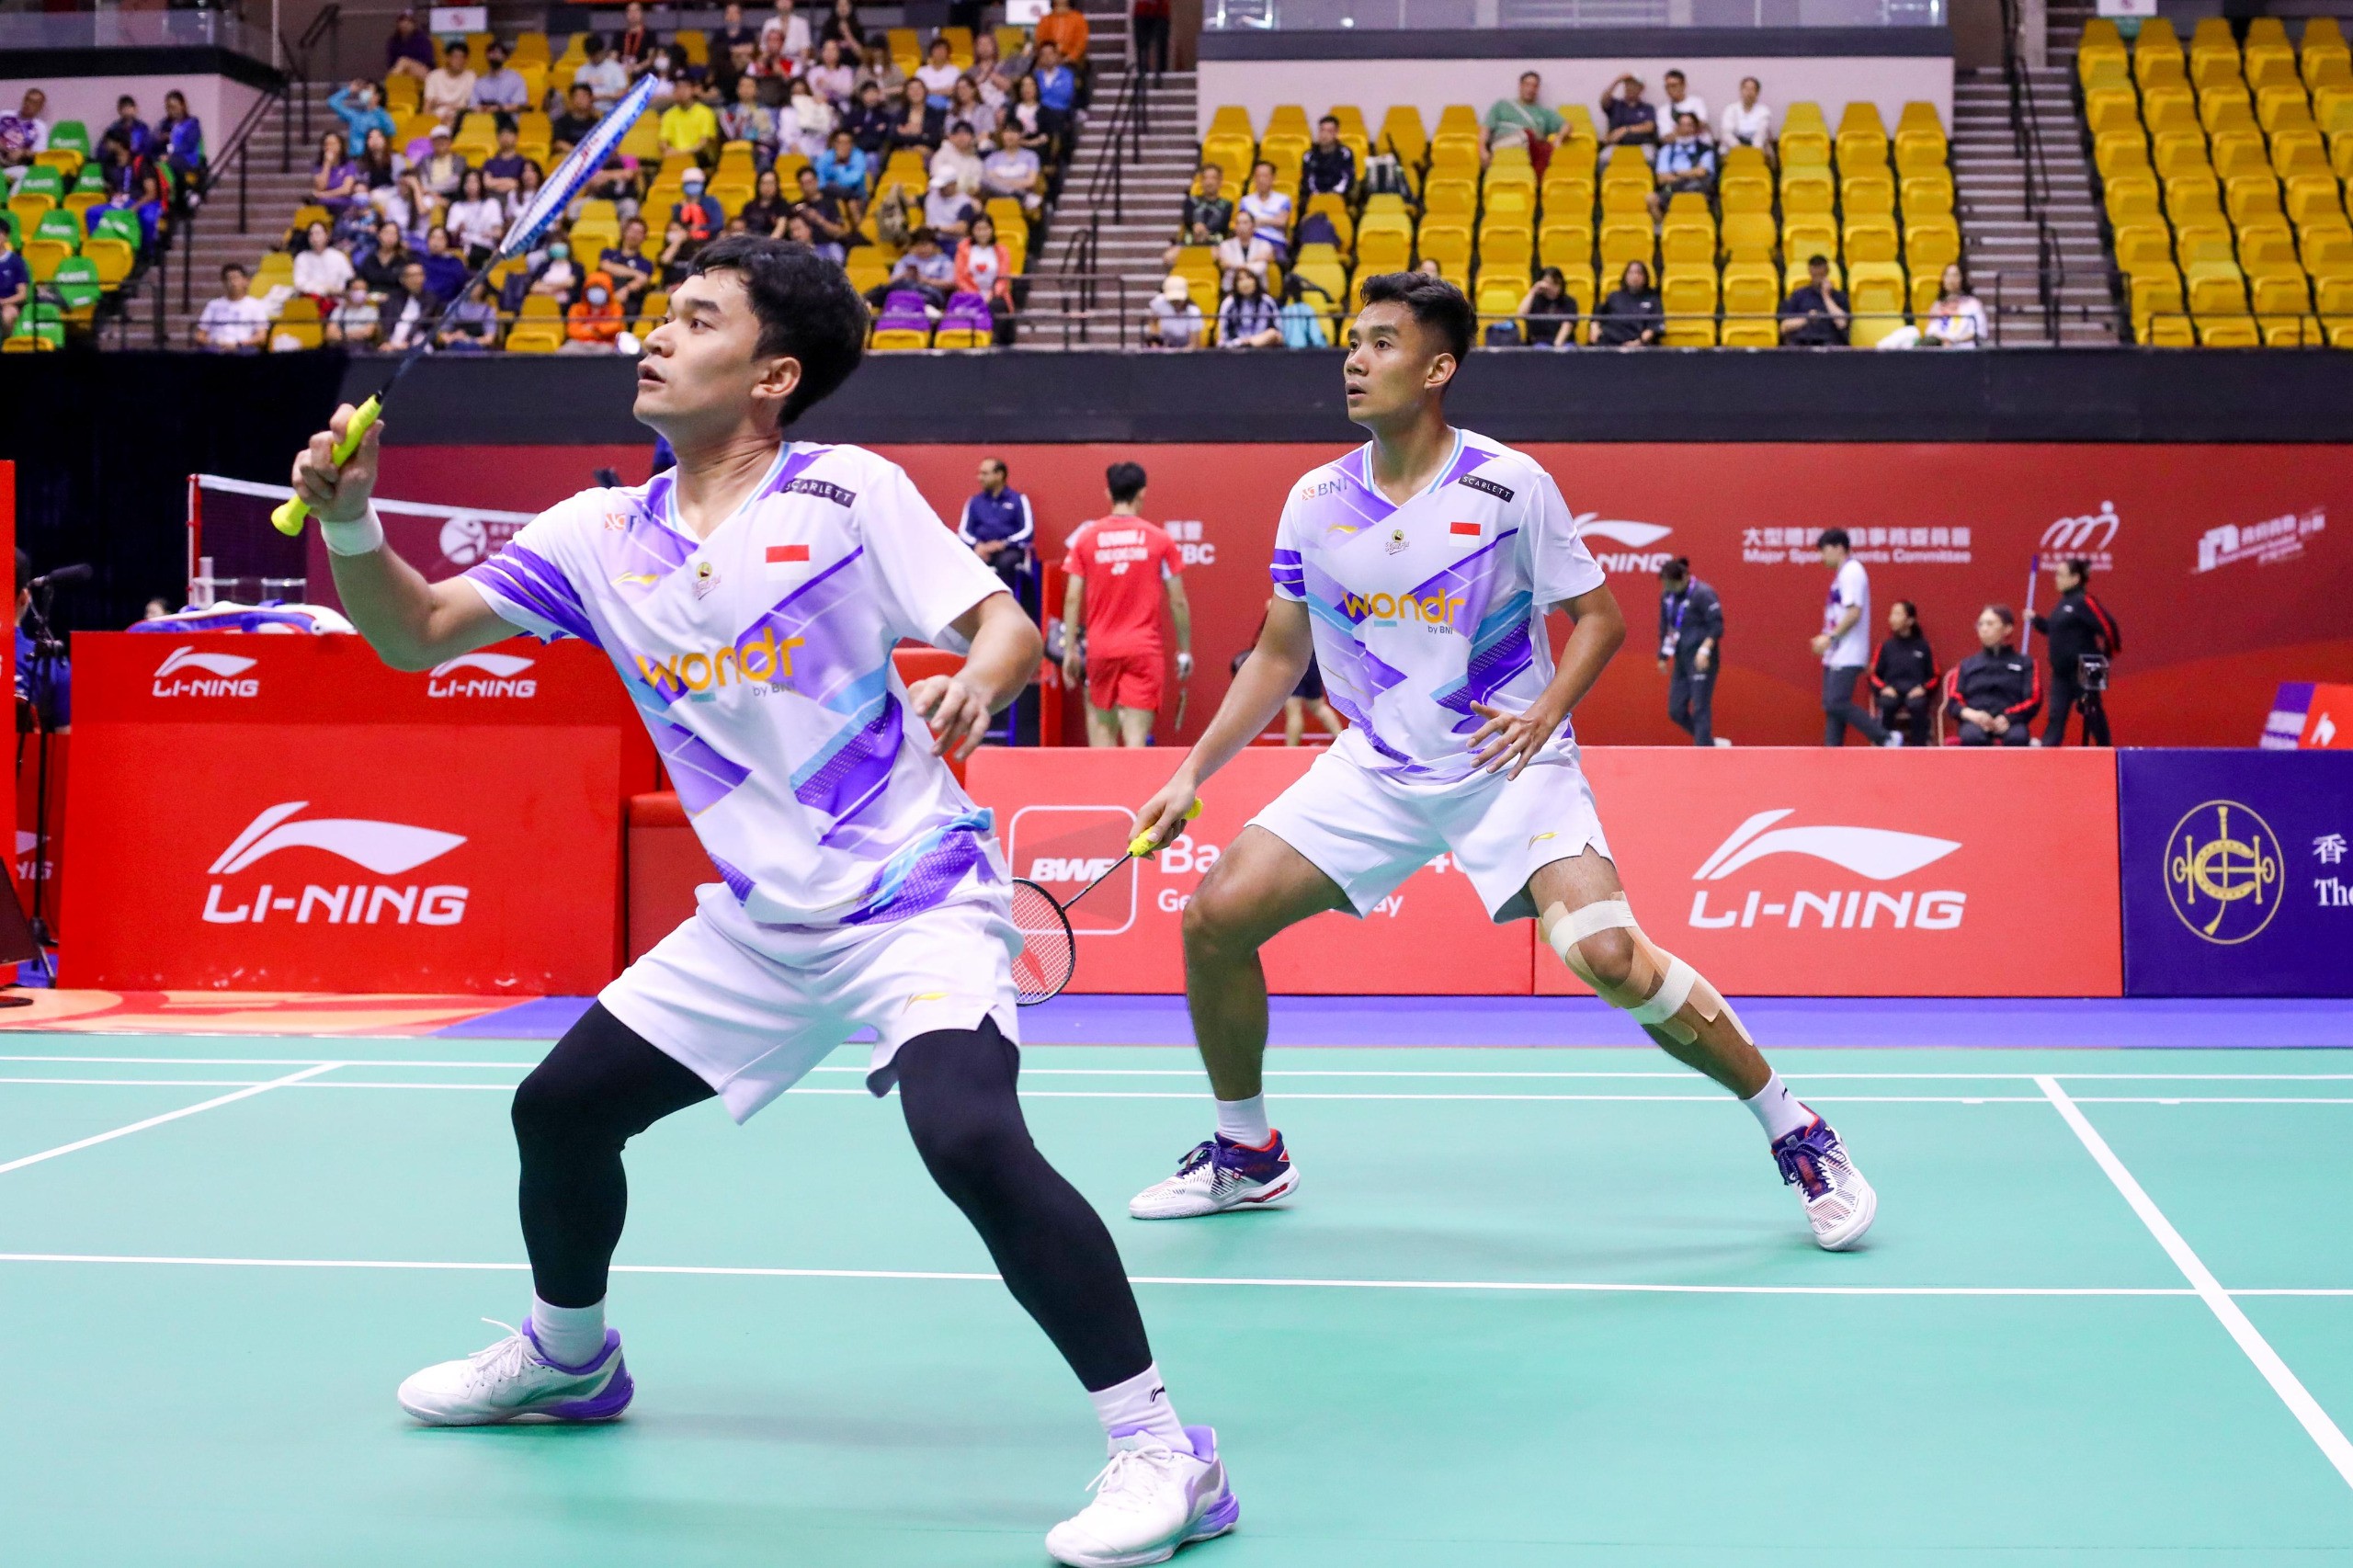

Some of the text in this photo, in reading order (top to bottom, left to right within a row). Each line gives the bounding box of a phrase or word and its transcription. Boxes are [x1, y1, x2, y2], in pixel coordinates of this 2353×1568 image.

[786, 480, 851, 502] SCARLETT
[1318, 478, 1347, 496] BNI
[1462, 476, 1510, 497] SCARLETT
[1597, 552, 1674, 573] NING
[1341, 588, 1466, 624] wondr
[1427, 625, 1453, 634] by BNI
[635, 627, 805, 692] wondr
[153, 678, 258, 698] LI-NING
[427, 679, 536, 699] LI-NING
[753, 686, 768, 697] by
[2313, 834, 2348, 864] 香
[1029, 858, 1117, 882] BWF
[202, 884, 470, 926] LI-NING
[1688, 890, 1967, 930] LI-NING
